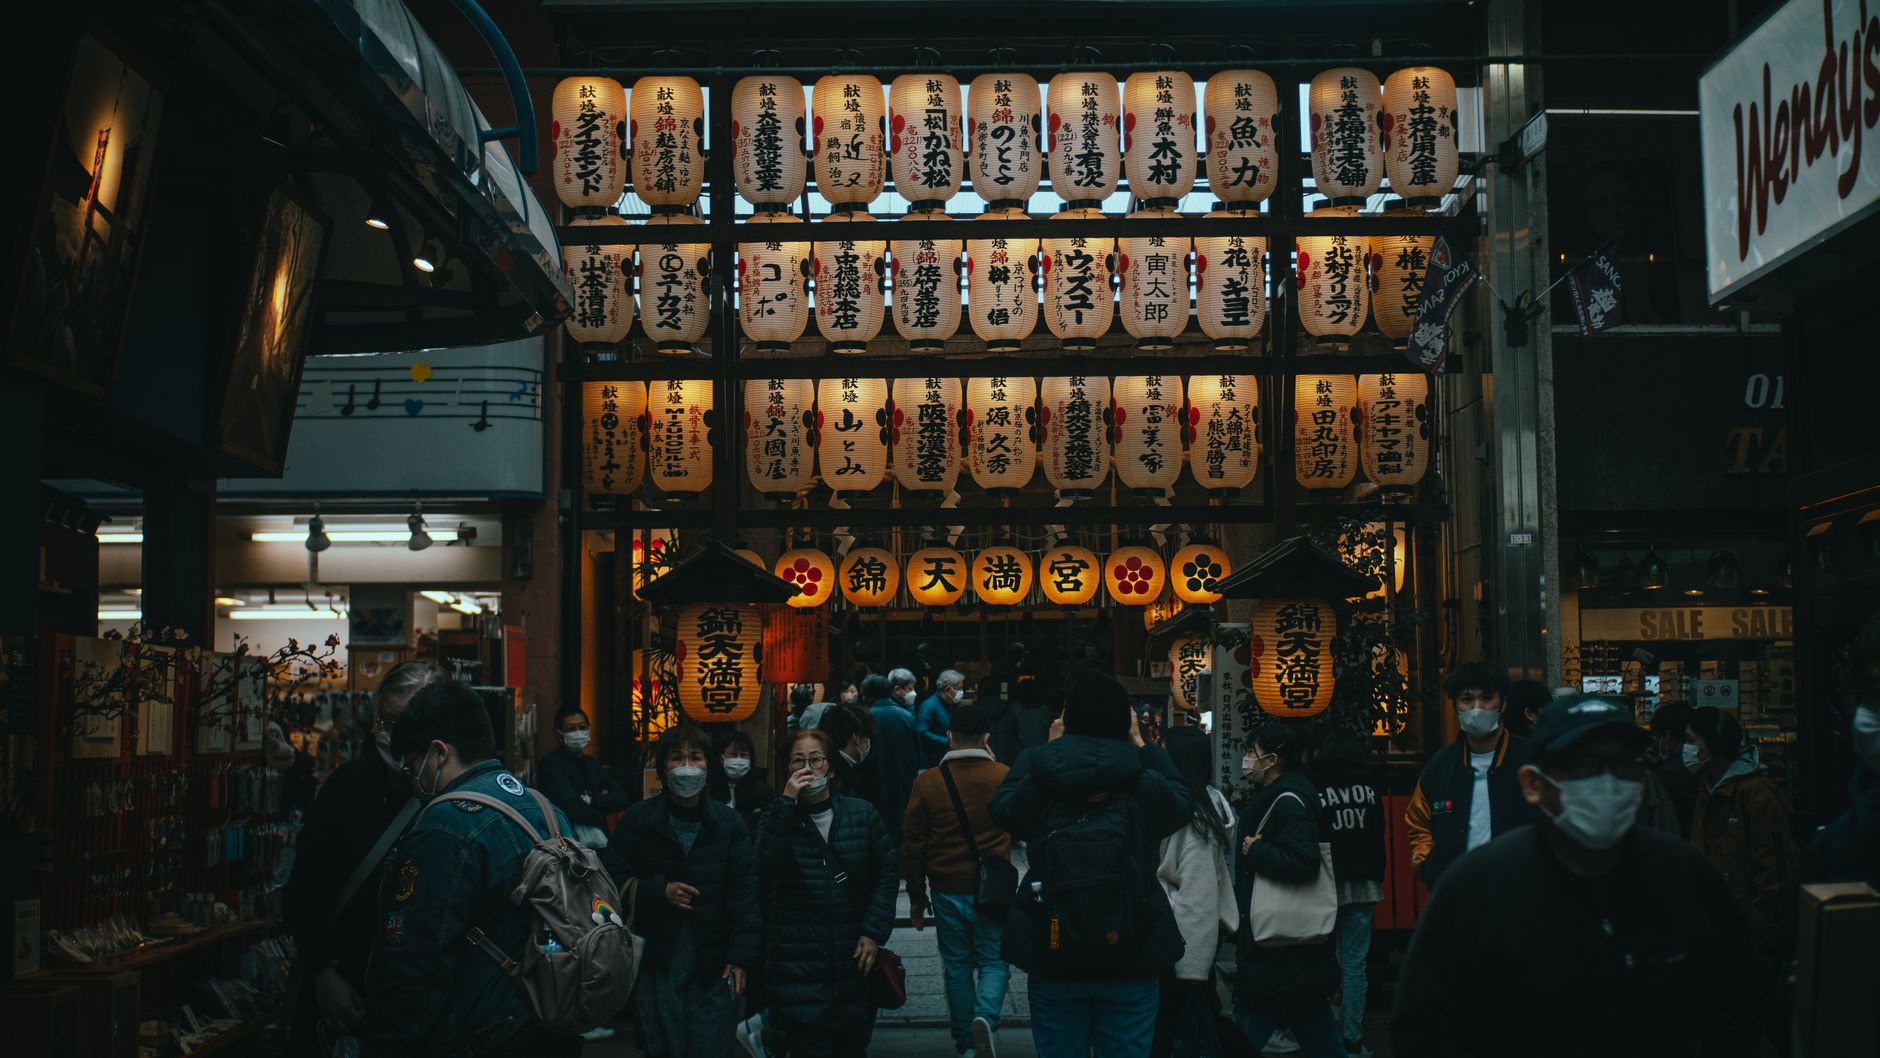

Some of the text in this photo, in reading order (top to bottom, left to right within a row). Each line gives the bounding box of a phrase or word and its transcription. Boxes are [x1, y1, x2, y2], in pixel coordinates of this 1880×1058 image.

[1228, 115, 1261, 187] 魚力
[1438, 105, 1450, 139] 京都
[1144, 253, 1170, 323] 寅太郎
[835, 409, 865, 475] 山とみ
[1275, 602, 1322, 709] 錦天満宮
[1640, 609, 1704, 640] SALE
[697, 607, 744, 714] 錦天満宮
[1332, 808, 1367, 831] JOY
